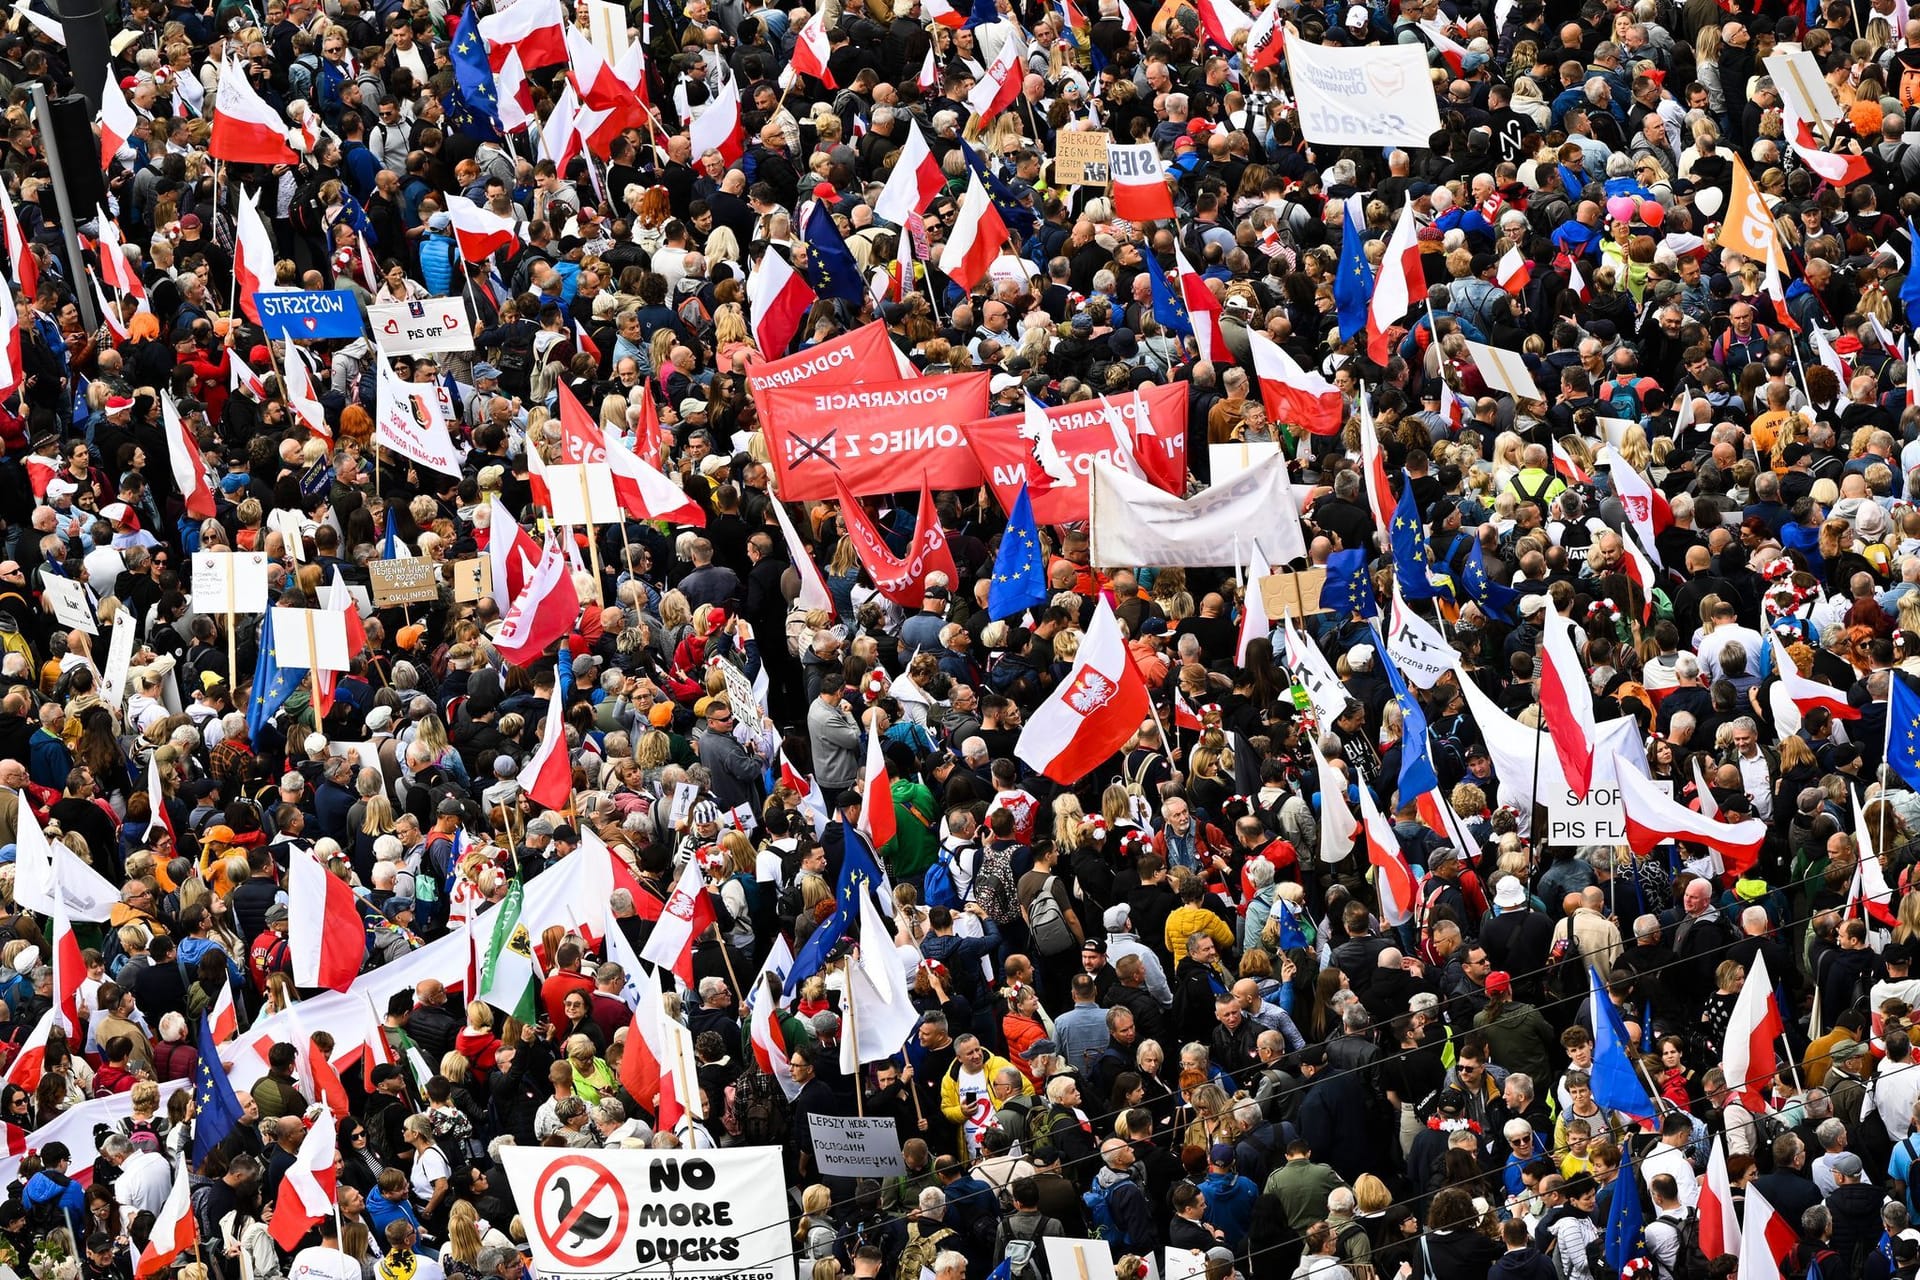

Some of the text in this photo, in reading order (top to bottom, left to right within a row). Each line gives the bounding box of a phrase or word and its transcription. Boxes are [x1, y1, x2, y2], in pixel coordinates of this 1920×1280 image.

[1061, 132, 1102, 146] SIERADZ
[263, 295, 343, 317] STRZYŻÓW
[426, 327, 443, 338] OFF
[1424, 662, 1440, 674] RP
[1552, 821, 1586, 839] PIS
[809, 1115, 896, 1129] LEPSZY HERR TUSK
[649, 1157, 716, 1193] NO
[638, 1201, 734, 1228] MORE
[635, 1237, 740, 1264] DUCKS
